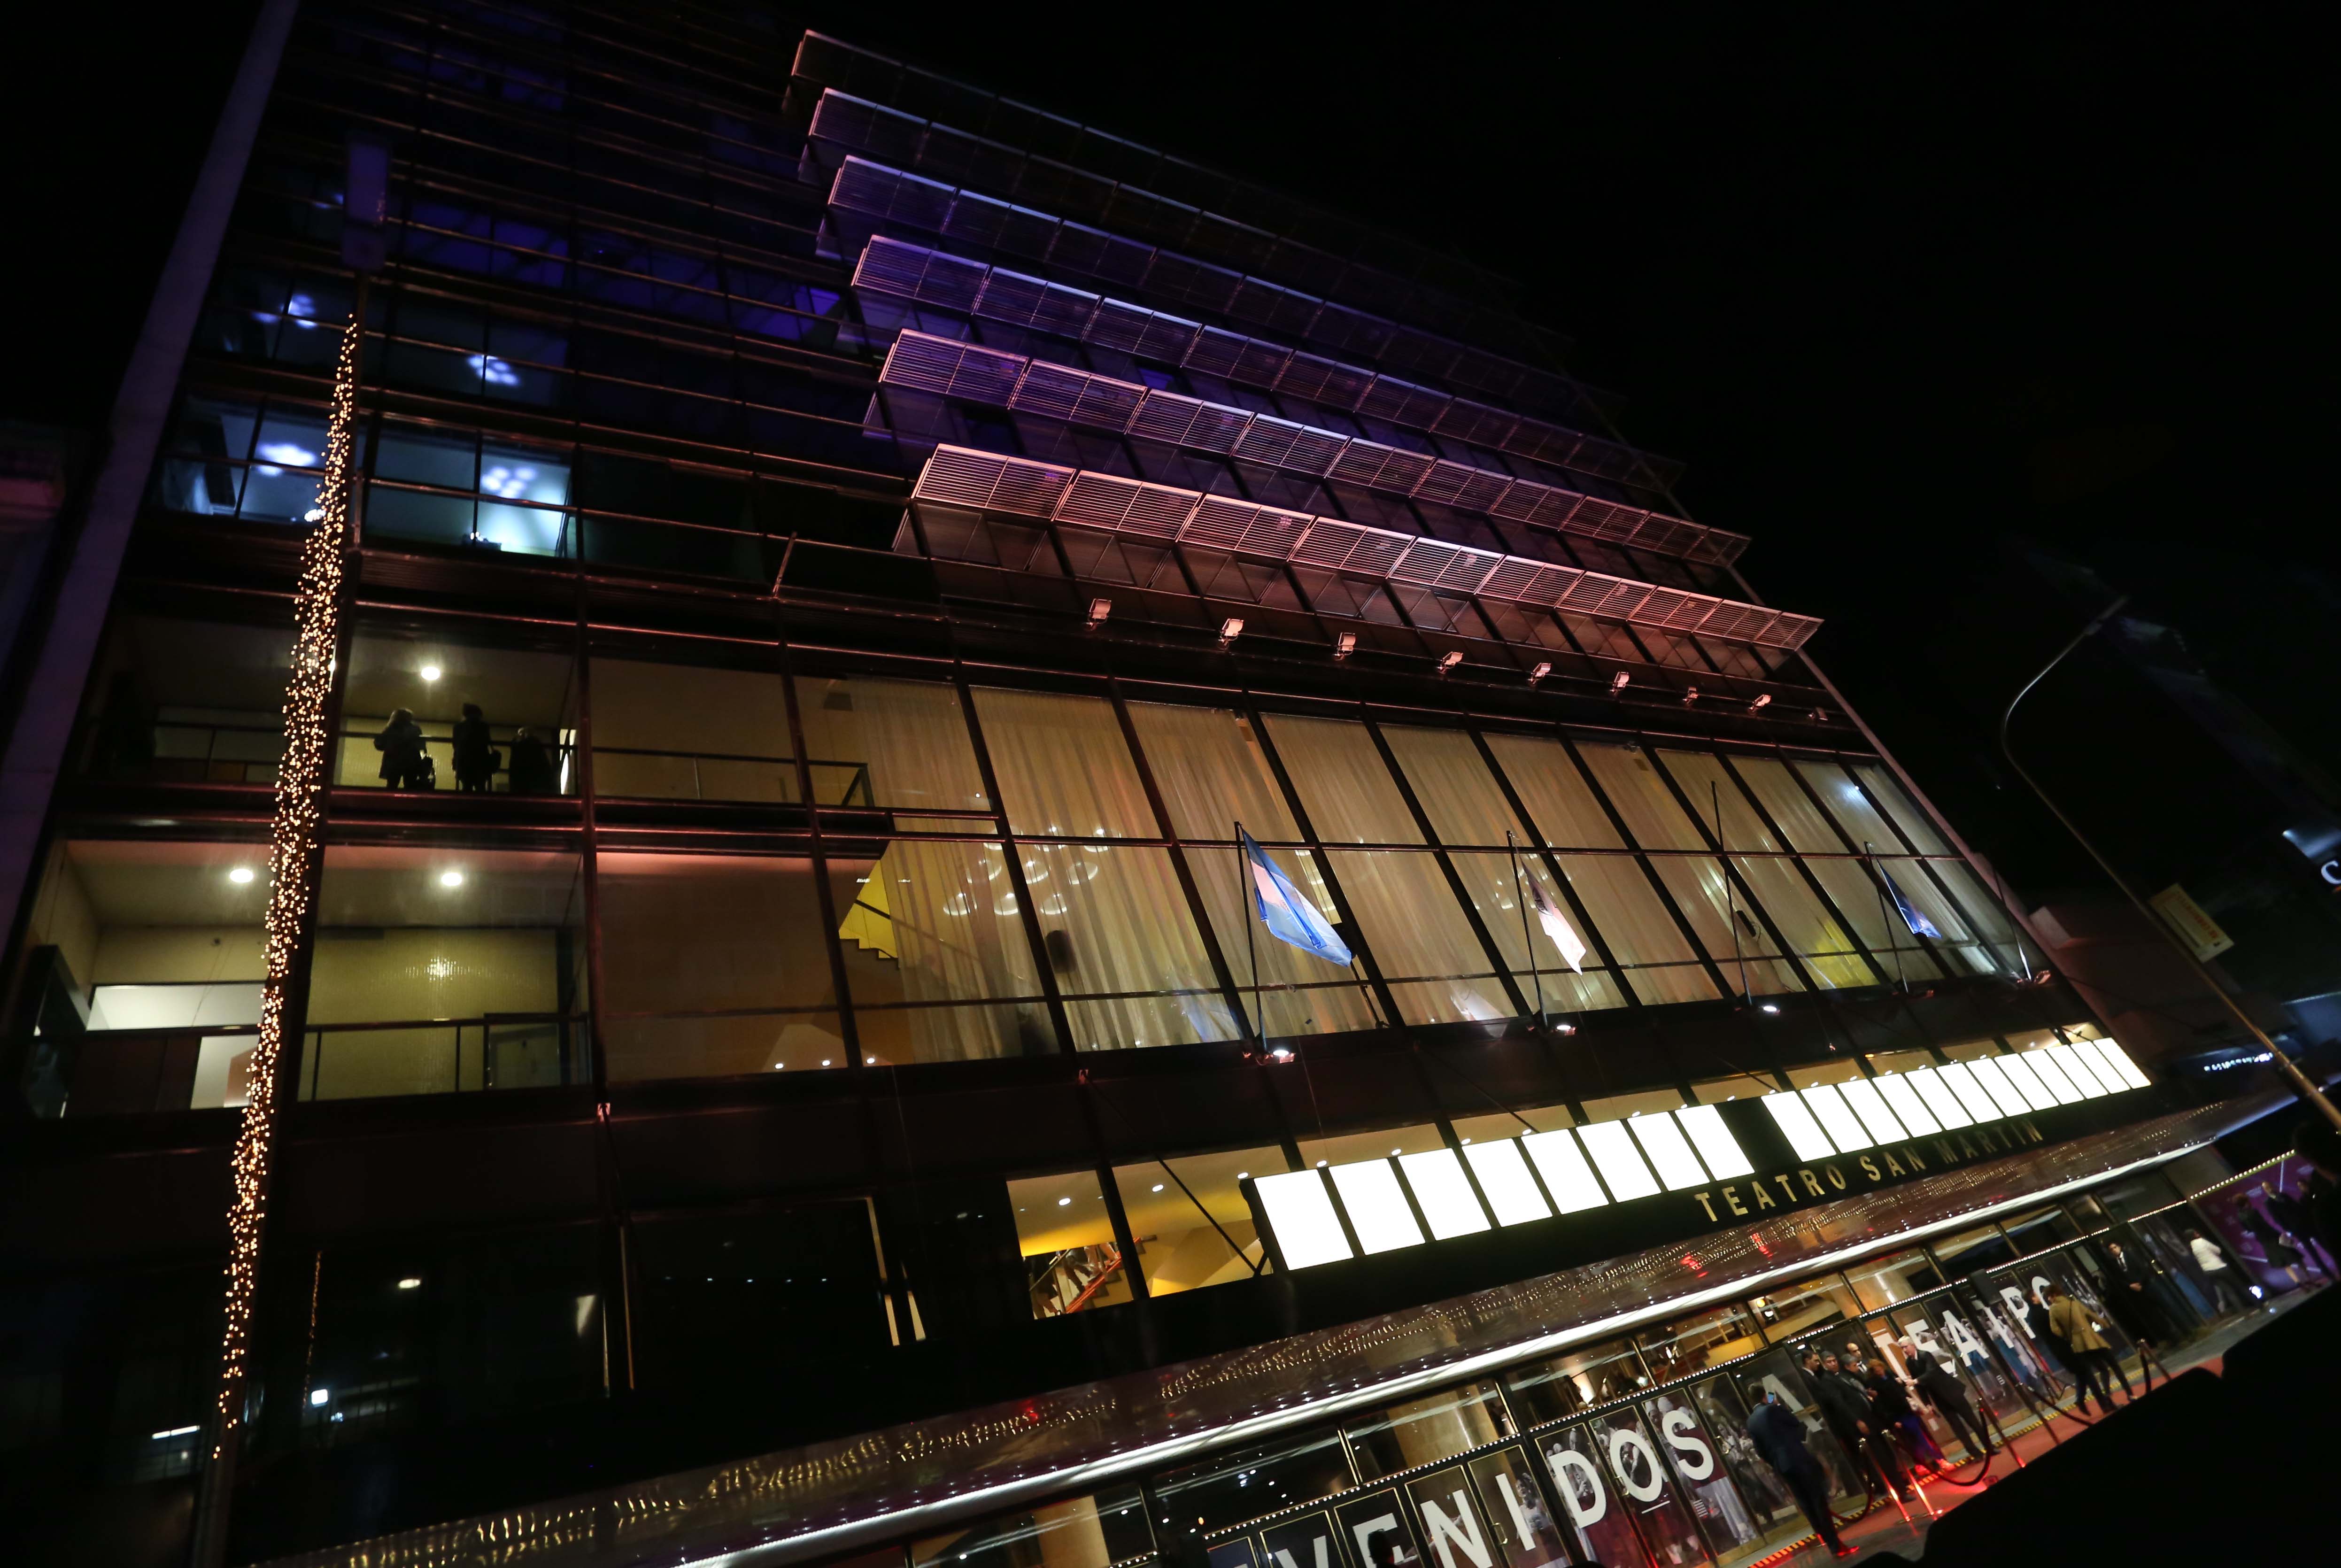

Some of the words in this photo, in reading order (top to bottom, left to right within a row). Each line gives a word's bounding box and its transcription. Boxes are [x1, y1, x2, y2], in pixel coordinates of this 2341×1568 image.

[1694, 1164, 1847, 1222] TEATRO
[1860, 1146, 1927, 1182] SAN
[1932, 1116, 2044, 1165] MARTIN
